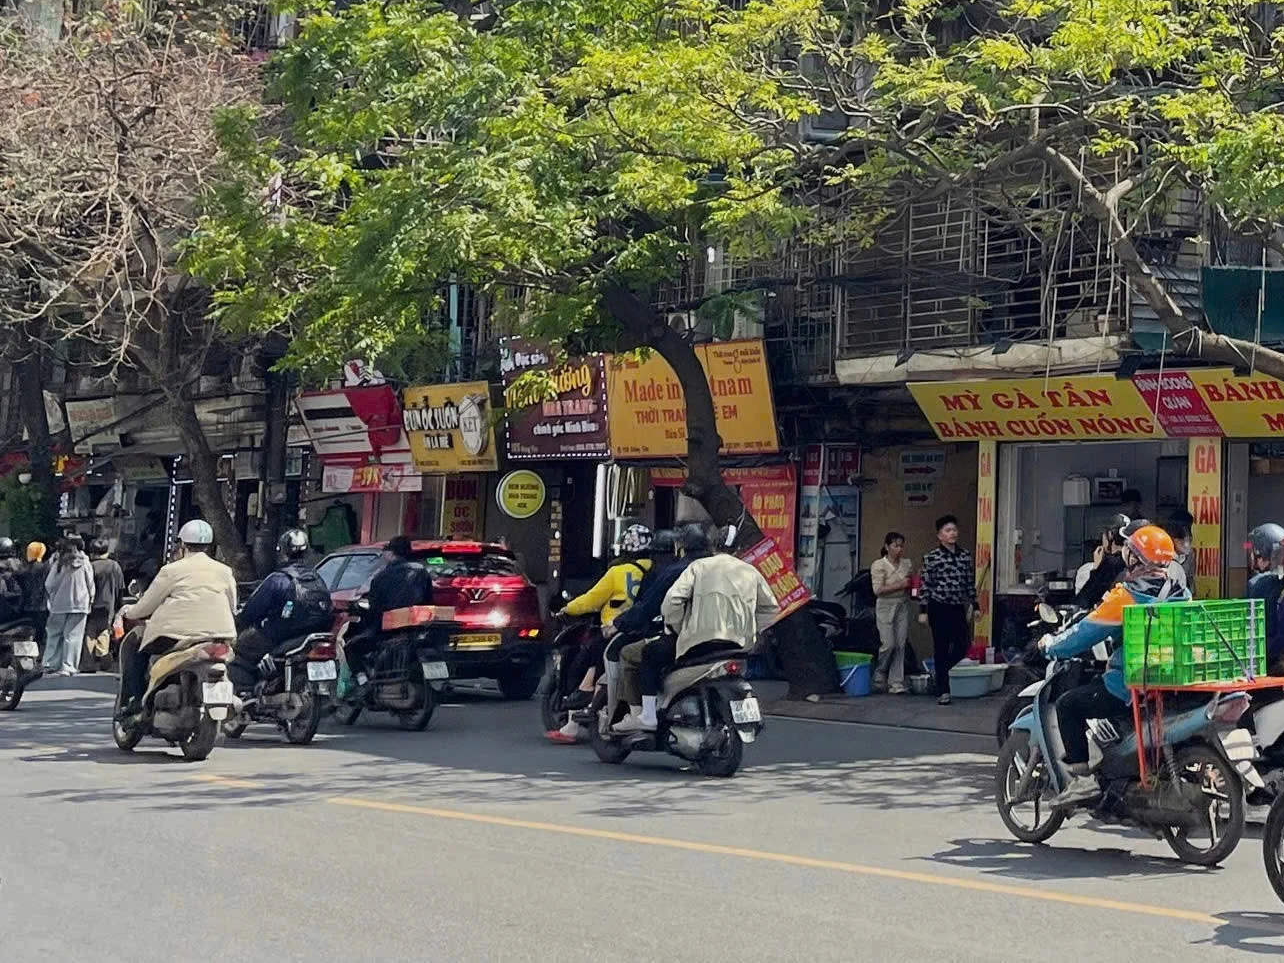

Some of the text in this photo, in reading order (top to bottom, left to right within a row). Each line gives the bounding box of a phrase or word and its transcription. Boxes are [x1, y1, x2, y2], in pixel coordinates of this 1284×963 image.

[624, 374, 753, 404] Made in tnam
[991, 386, 1039, 410] GÀ
[1042, 381, 1114, 408] TẦN
[722, 405, 738, 420] EM
[934, 411, 1155, 438] BÁNH CUỐN NÓNG
[1194, 439, 1217, 474] GÀ
